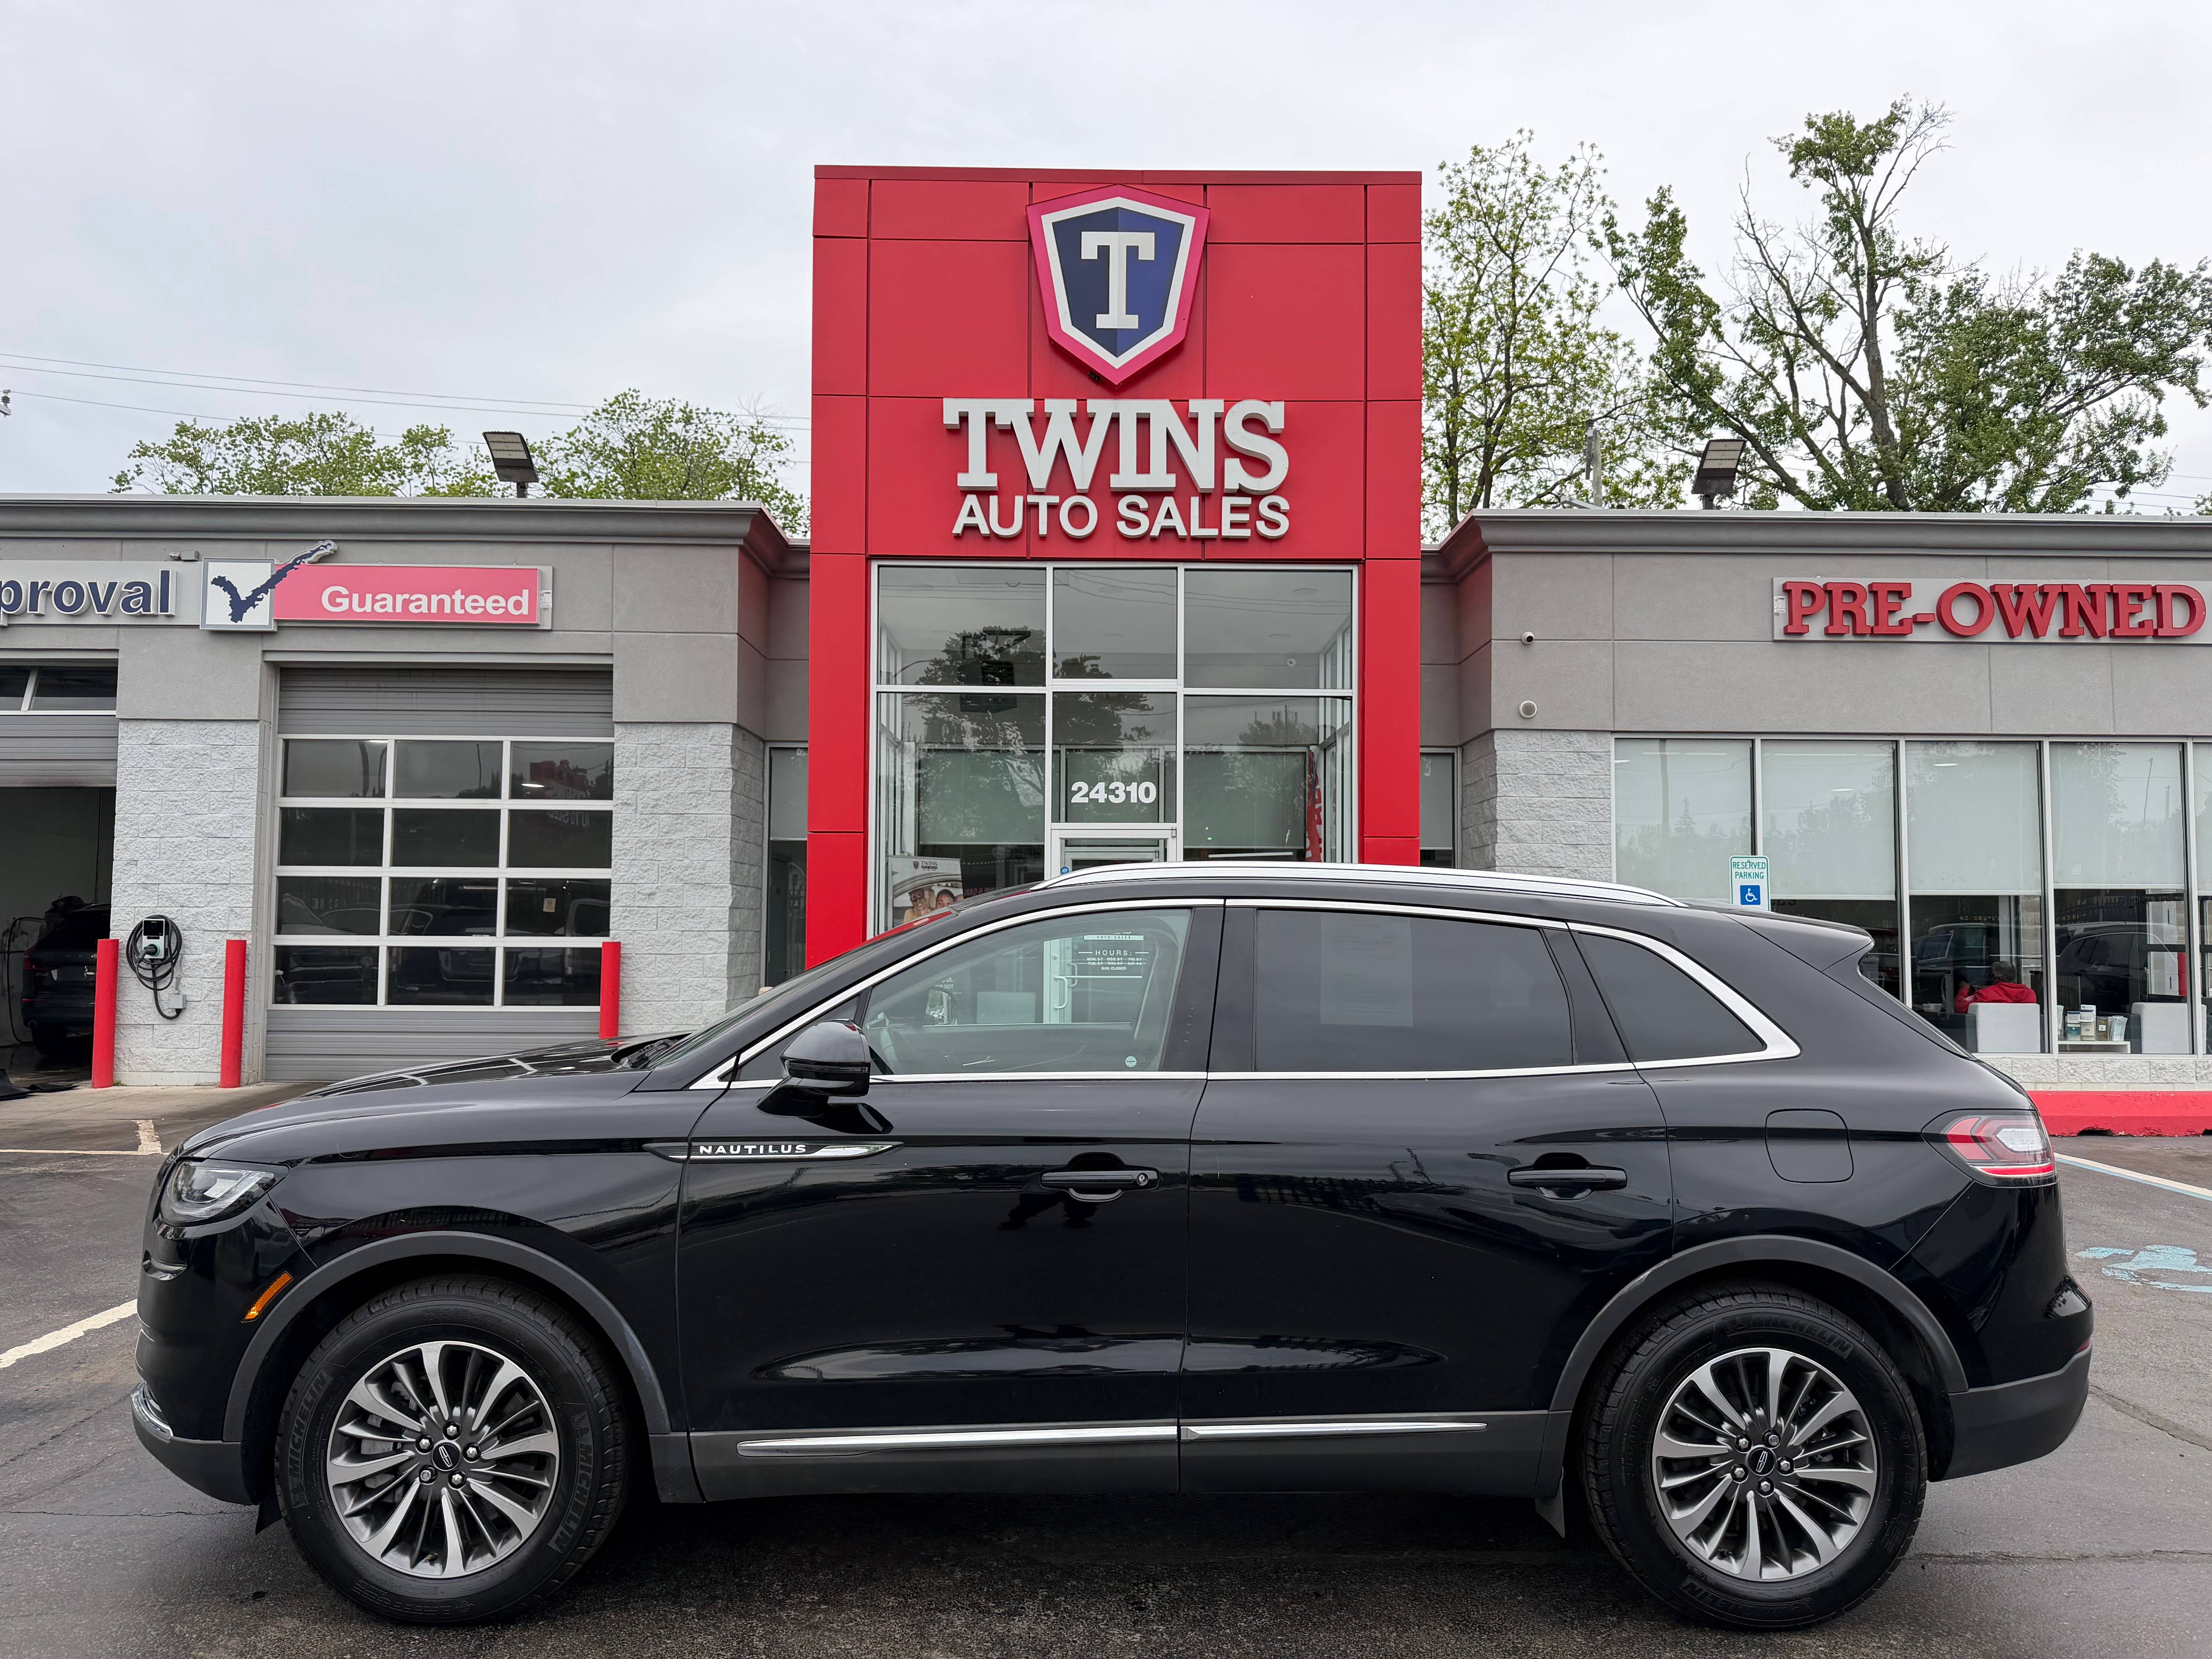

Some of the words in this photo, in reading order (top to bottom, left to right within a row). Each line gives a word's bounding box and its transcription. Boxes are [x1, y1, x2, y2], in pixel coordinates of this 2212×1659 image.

[1081, 231, 1155, 329] T
[943, 397, 1289, 494] TWINS
[952, 494, 1098, 538] AUTO
[1116, 495, 1290, 538] SALES
[321, 586, 529, 615] Guaranteed
[1782, 581, 2207, 638] PRE-OWNED
[1071, 781, 1157, 804] 24310
[699, 1144, 806, 1155] NAUTILUS
[1748, 1313, 1853, 1355] MICHELIN
[289, 1370, 330, 1480] MICHELIN
[551, 1441, 592, 1552] MICHELIN
